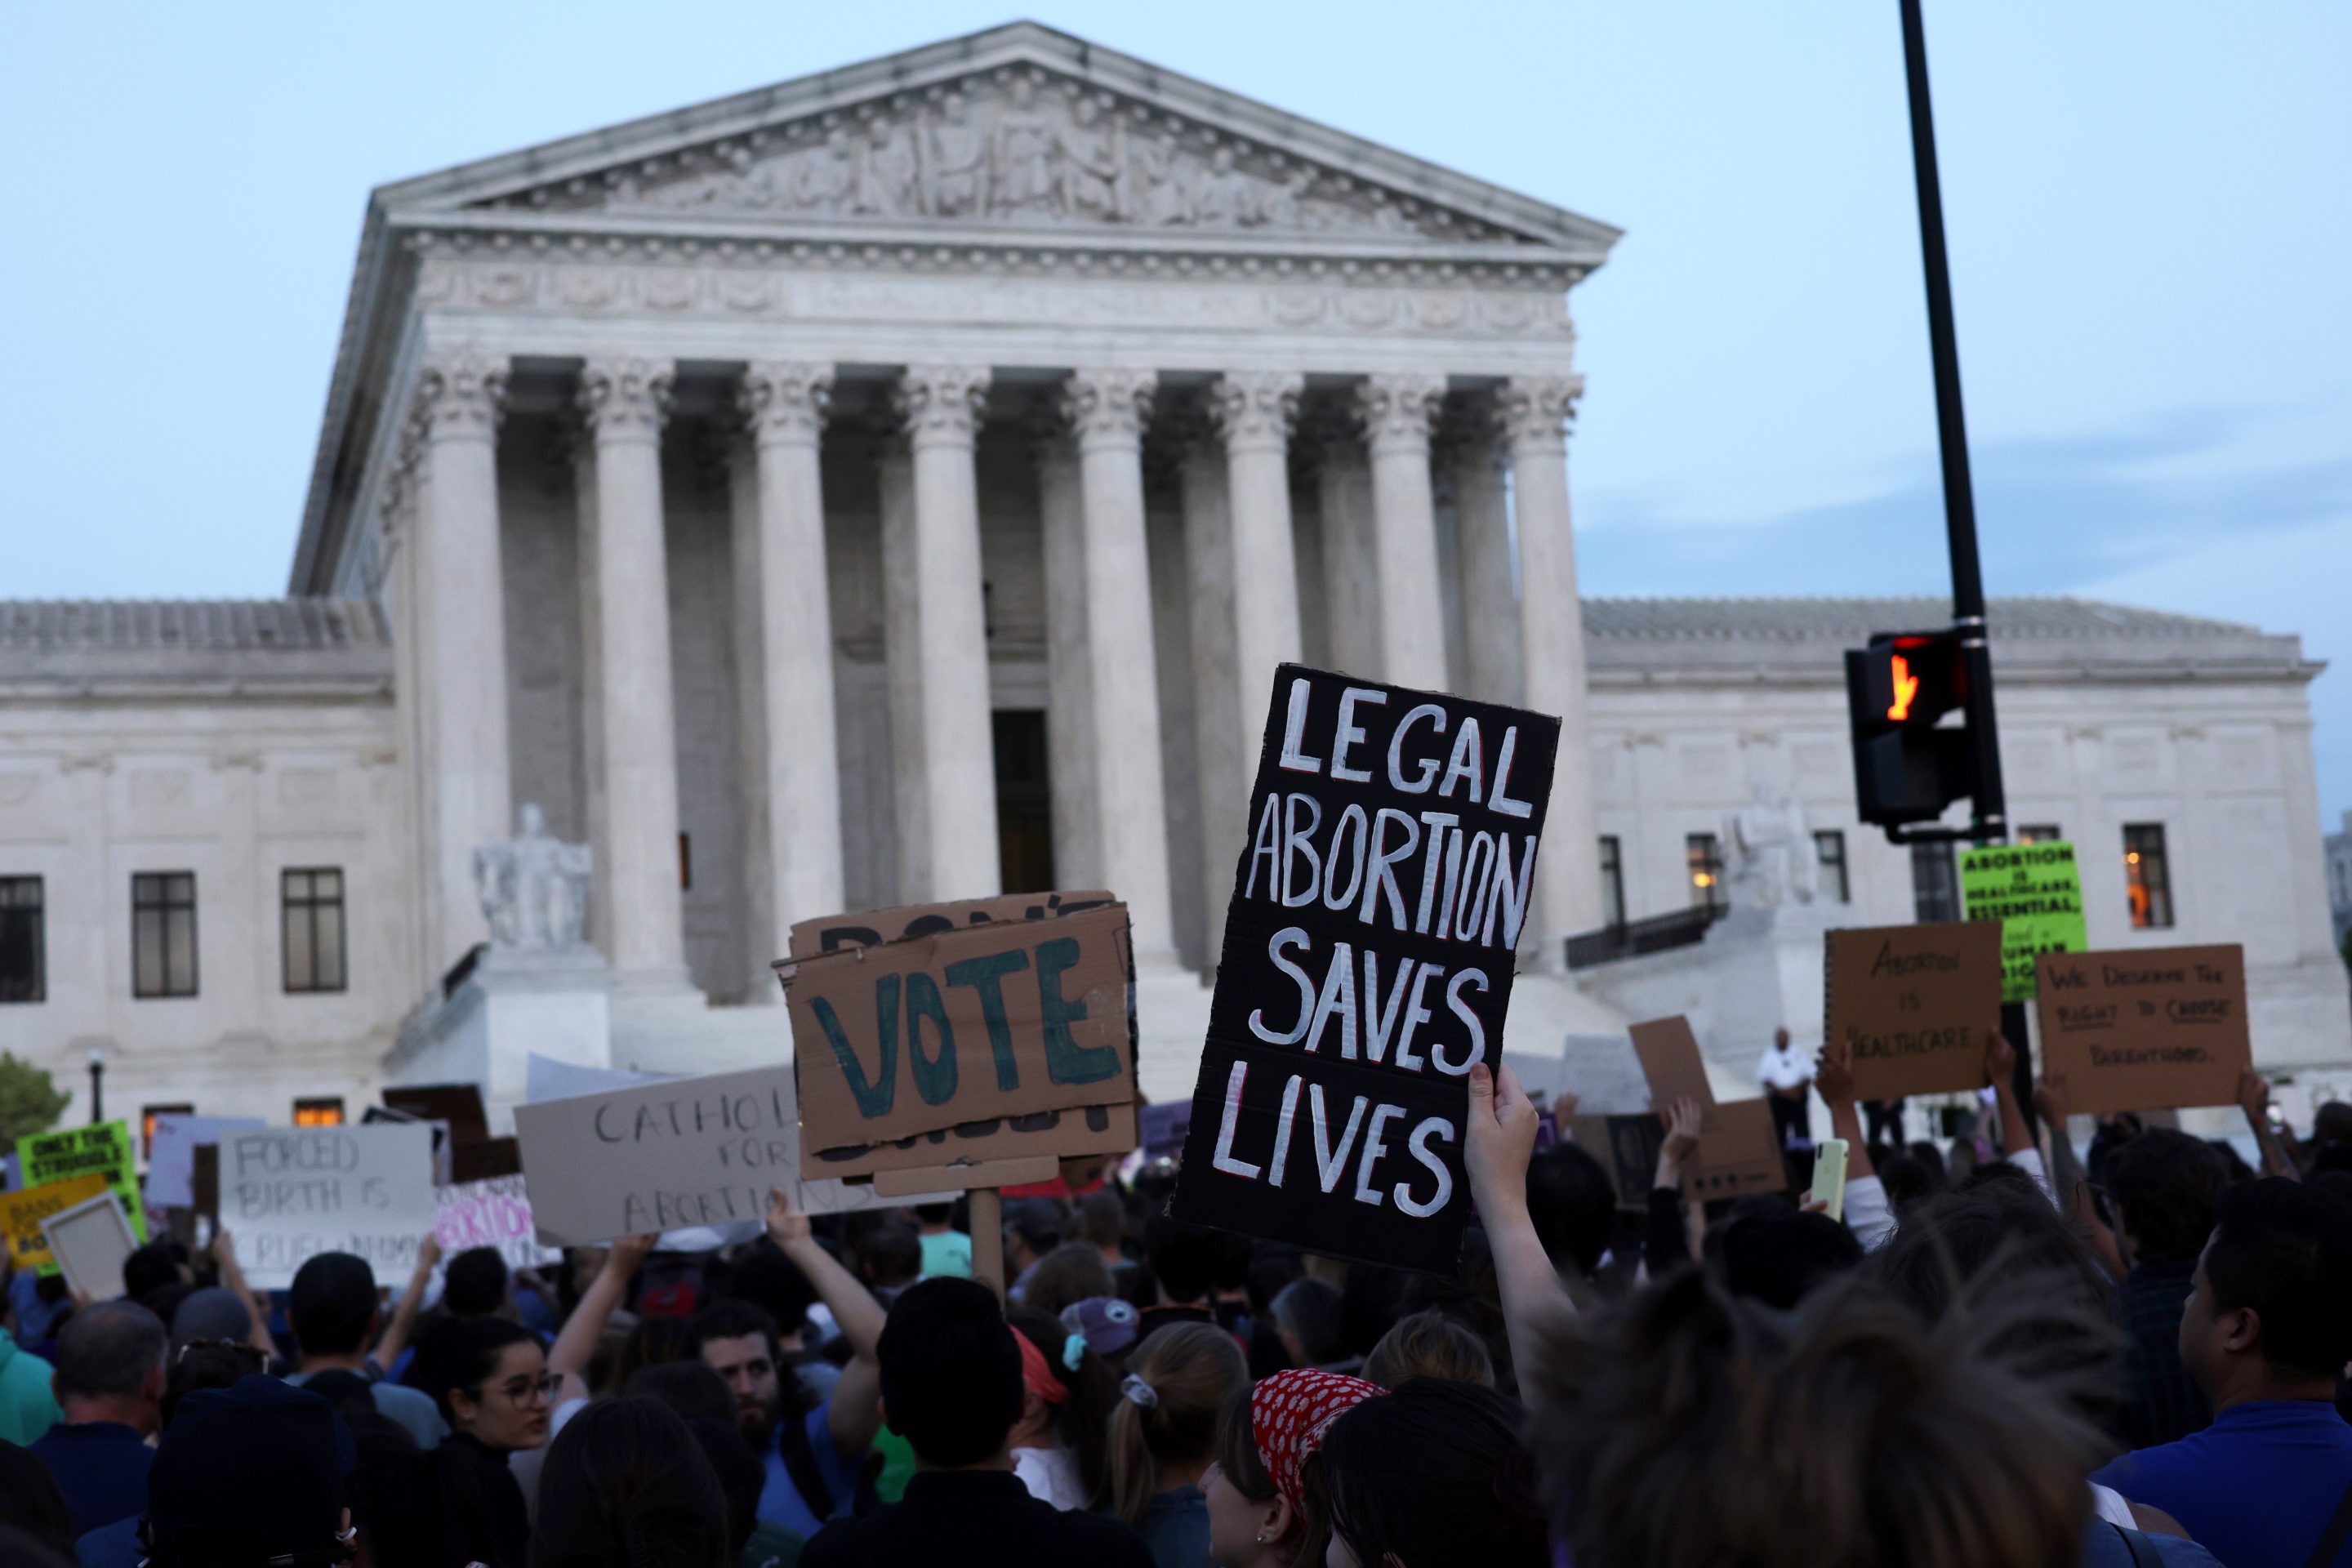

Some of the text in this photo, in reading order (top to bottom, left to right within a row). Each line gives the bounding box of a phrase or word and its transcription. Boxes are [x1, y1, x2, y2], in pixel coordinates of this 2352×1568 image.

[1279, 678, 1532, 817] LEGAL
[1245, 793, 1535, 950] ABORTION
[1965, 849, 2073, 871] ABORTION
[2003, 943, 2067, 960] UMAN
[810, 938, 1122, 1119] VOTE
[1249, 927, 1489, 1076] SAVES
[595, 1086, 798, 1143] CATHOL
[1213, 1061, 1454, 1217] LIVES
[236, 1133, 359, 1175] FORCED
[718, 1140, 789, 1168] FOR
[237, 1177, 341, 1220] BIRTH
[361, 1176, 390, 1211] IS
